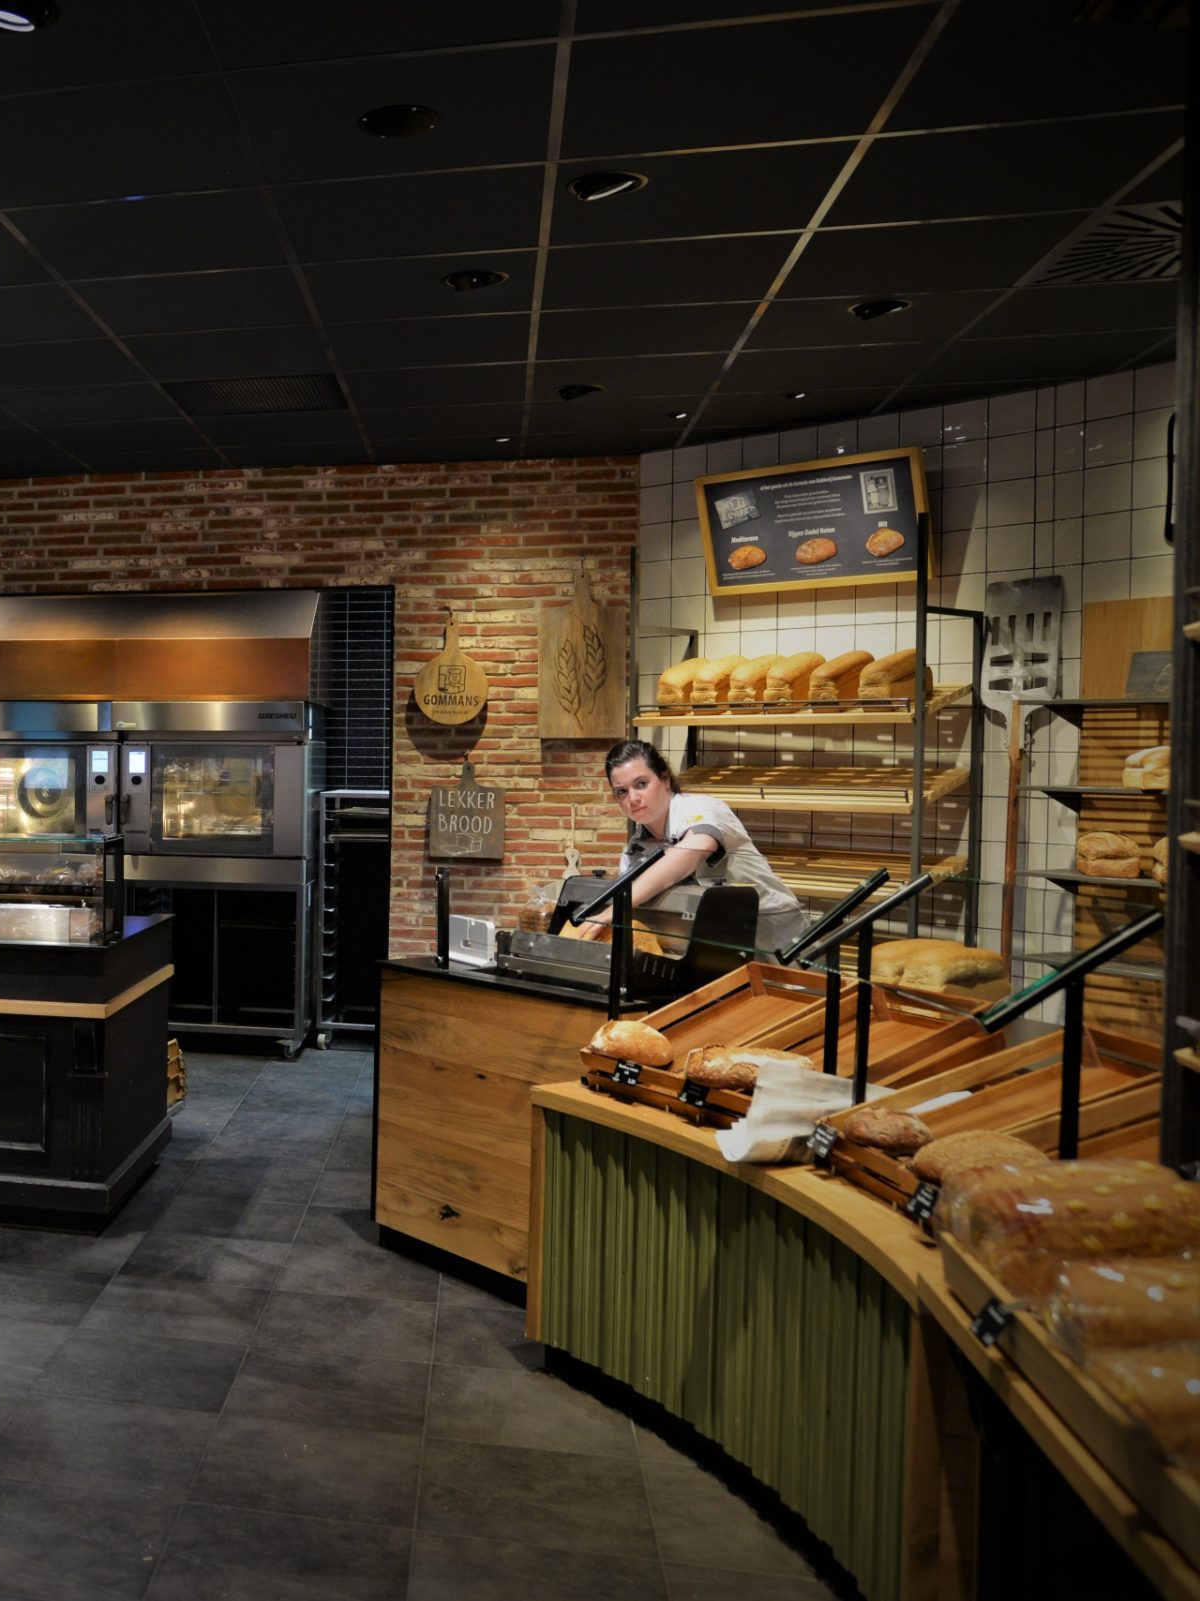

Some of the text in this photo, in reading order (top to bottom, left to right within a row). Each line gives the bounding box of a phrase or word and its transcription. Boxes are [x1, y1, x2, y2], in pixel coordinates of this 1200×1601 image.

[788, 526, 836, 539] Vijgen Dadel Noten
[423, 694, 480, 707] GOMMANS
[439, 790, 495, 810] LEKKER
[438, 814, 492, 834] BROOD
